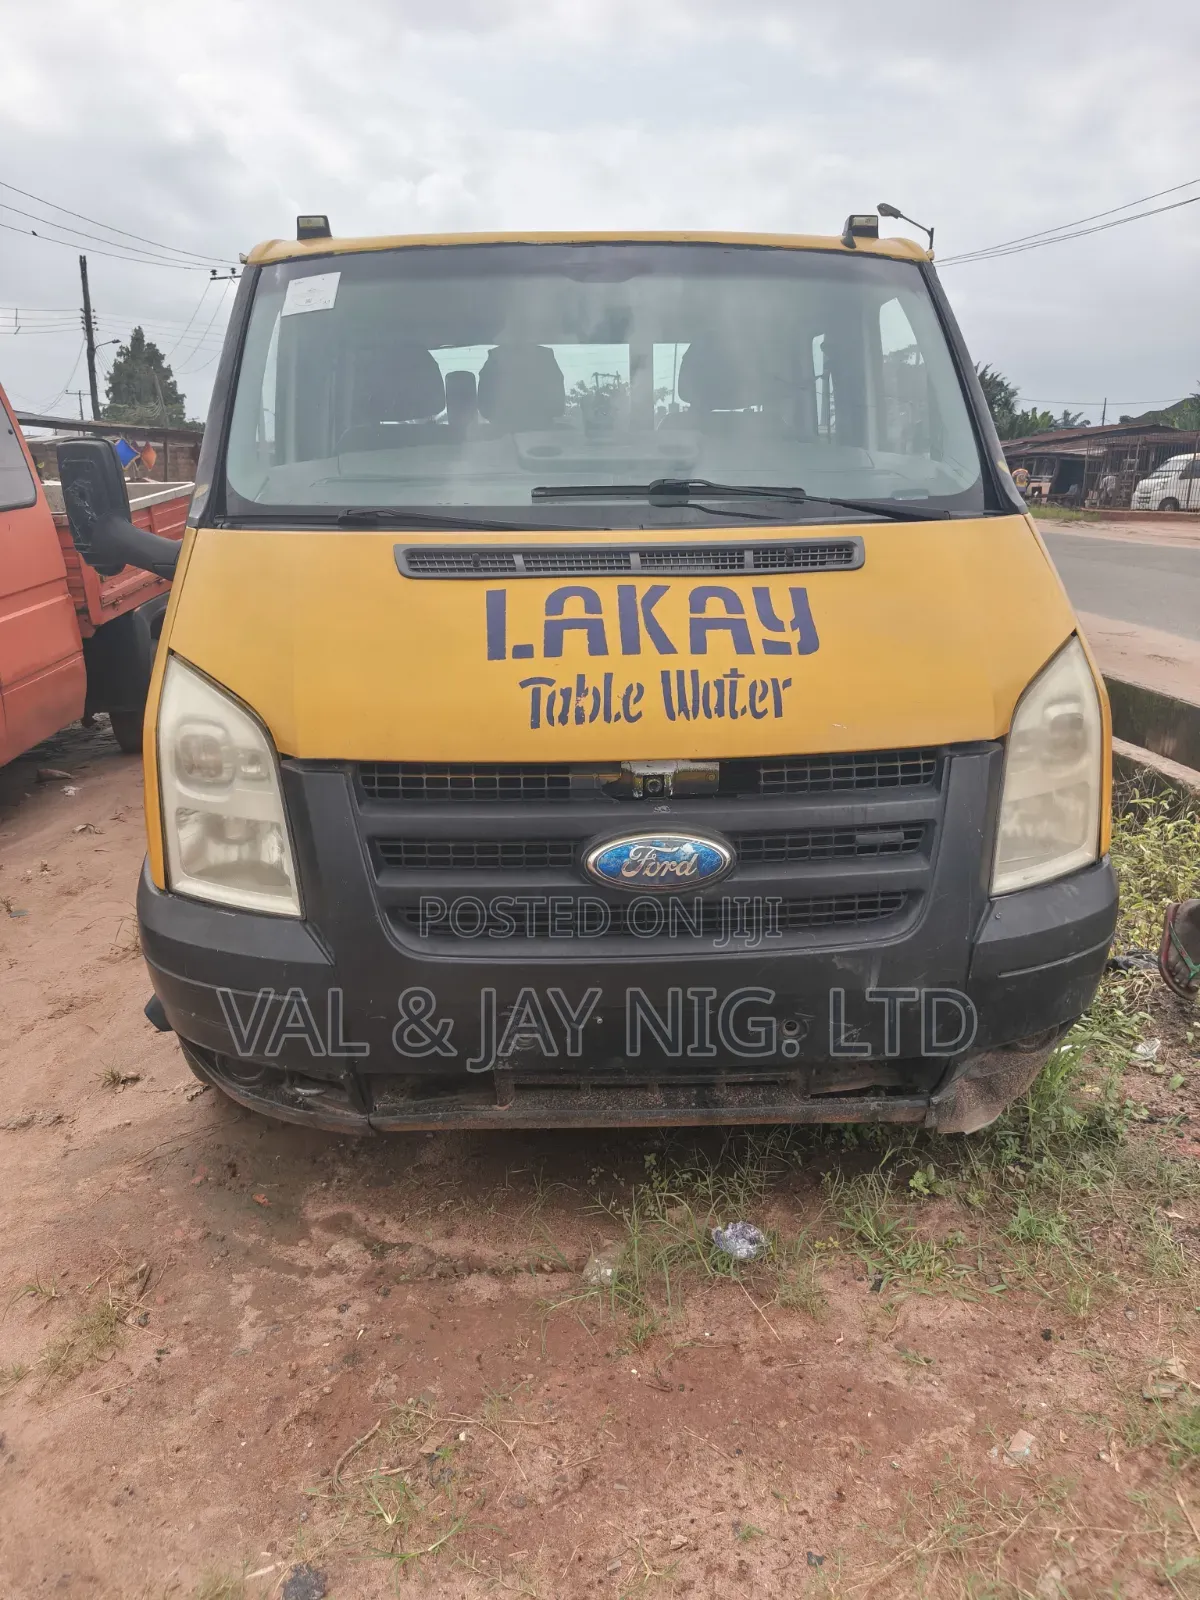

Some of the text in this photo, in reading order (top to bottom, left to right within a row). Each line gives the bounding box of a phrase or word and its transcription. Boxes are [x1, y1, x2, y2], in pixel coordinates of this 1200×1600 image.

[486, 584, 820, 661] LAKAY
[518, 667, 792, 730] Table Water
[620, 844, 698, 878] Ford
